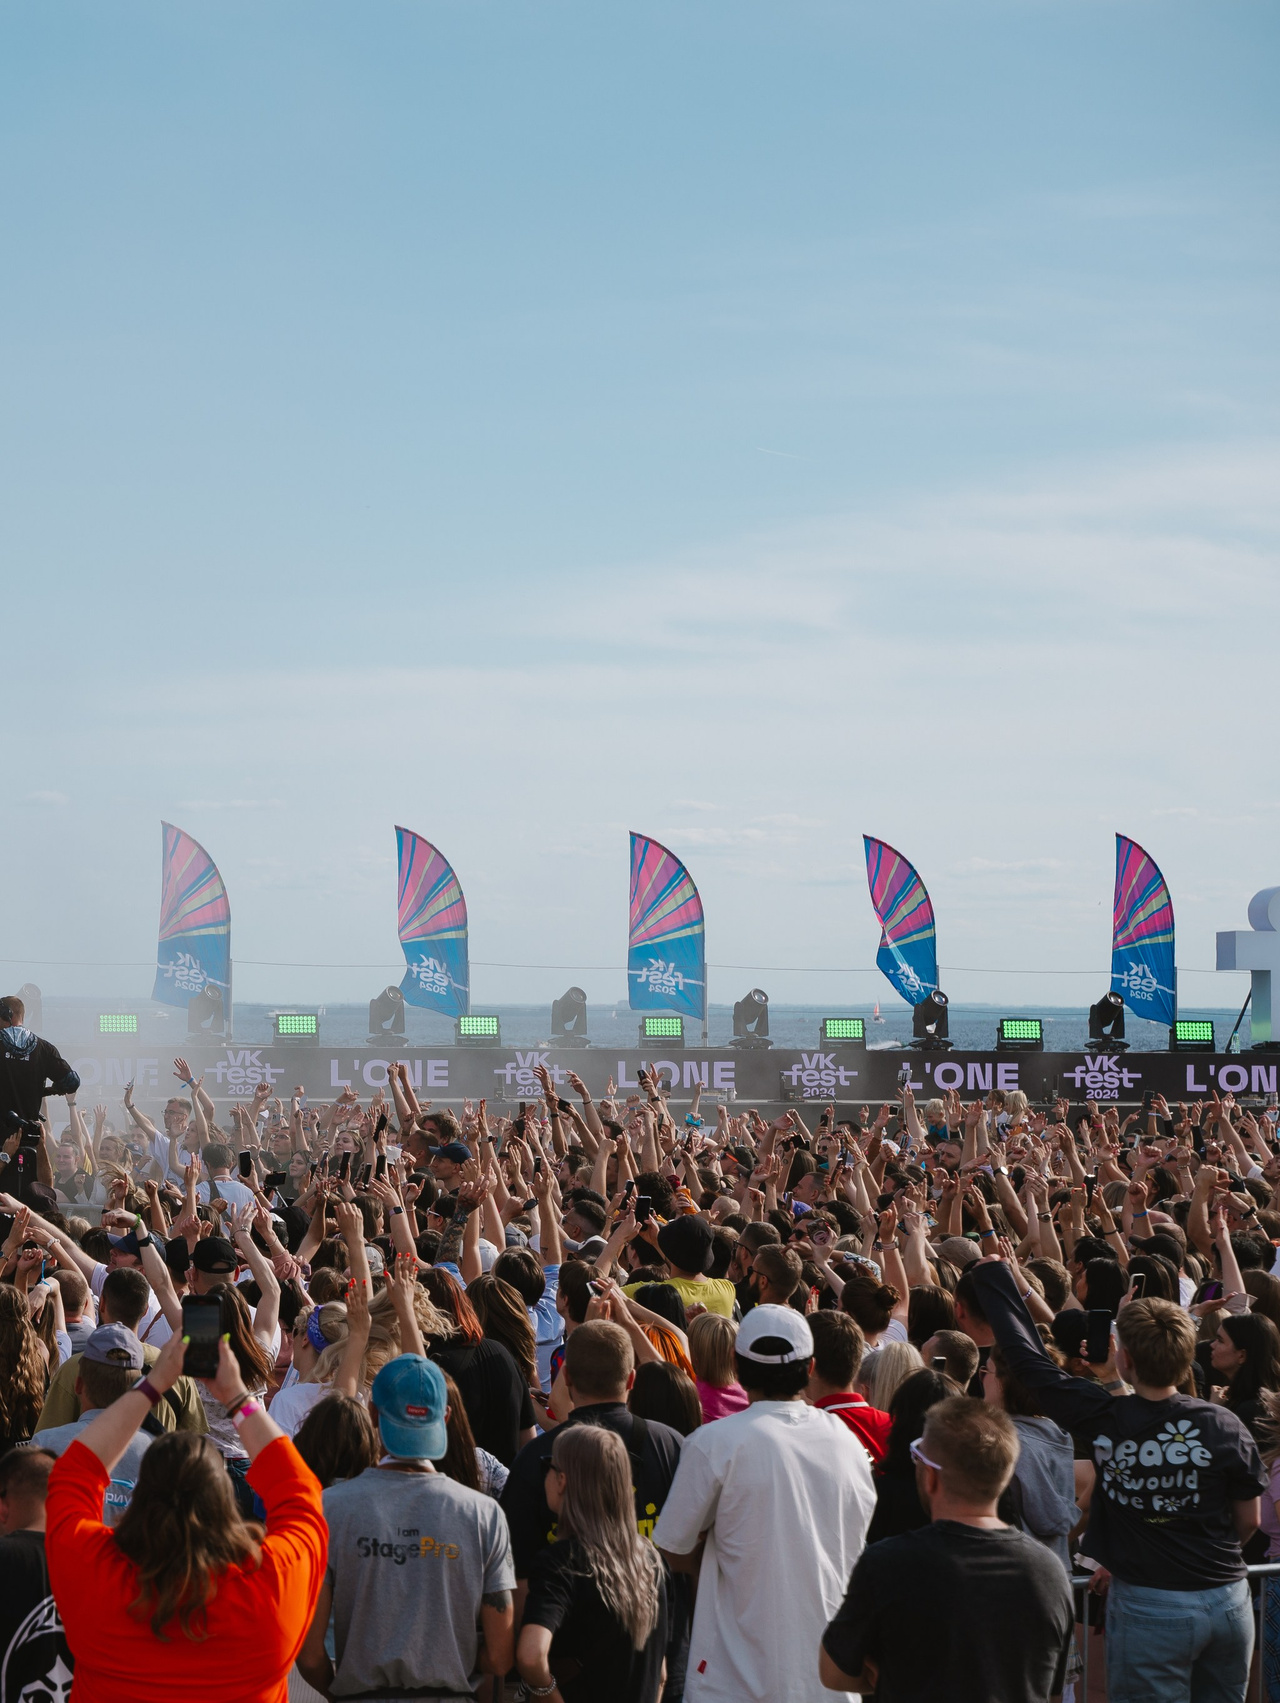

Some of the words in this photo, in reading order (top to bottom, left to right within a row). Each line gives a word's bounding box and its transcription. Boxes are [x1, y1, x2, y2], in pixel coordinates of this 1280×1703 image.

[226, 1051, 263, 1066] VK
[515, 1052, 551, 1067] VK
[802, 1053, 836, 1069] VK
[1084, 1055, 1120, 1071] VK
[71, 1059, 159, 1086] ONE
[205, 1062, 284, 1083] fest
[494, 1062, 573, 1084] fet
[780, 1064, 858, 1086] fest
[902, 1062, 1019, 1090] L'ONE
[1063, 1066, 1142, 1088] fest
[1186, 1064, 1277, 1092] L'ON
[517, 1086, 545, 1095] 202
[802, 1087, 836, 1097] 2024
[1086, 1089, 1119, 1099] 2024
[1122, 1469, 1198, 1490] would
[402, 1528, 419, 1537] am
[357, 1536, 460, 1565] StagePro
